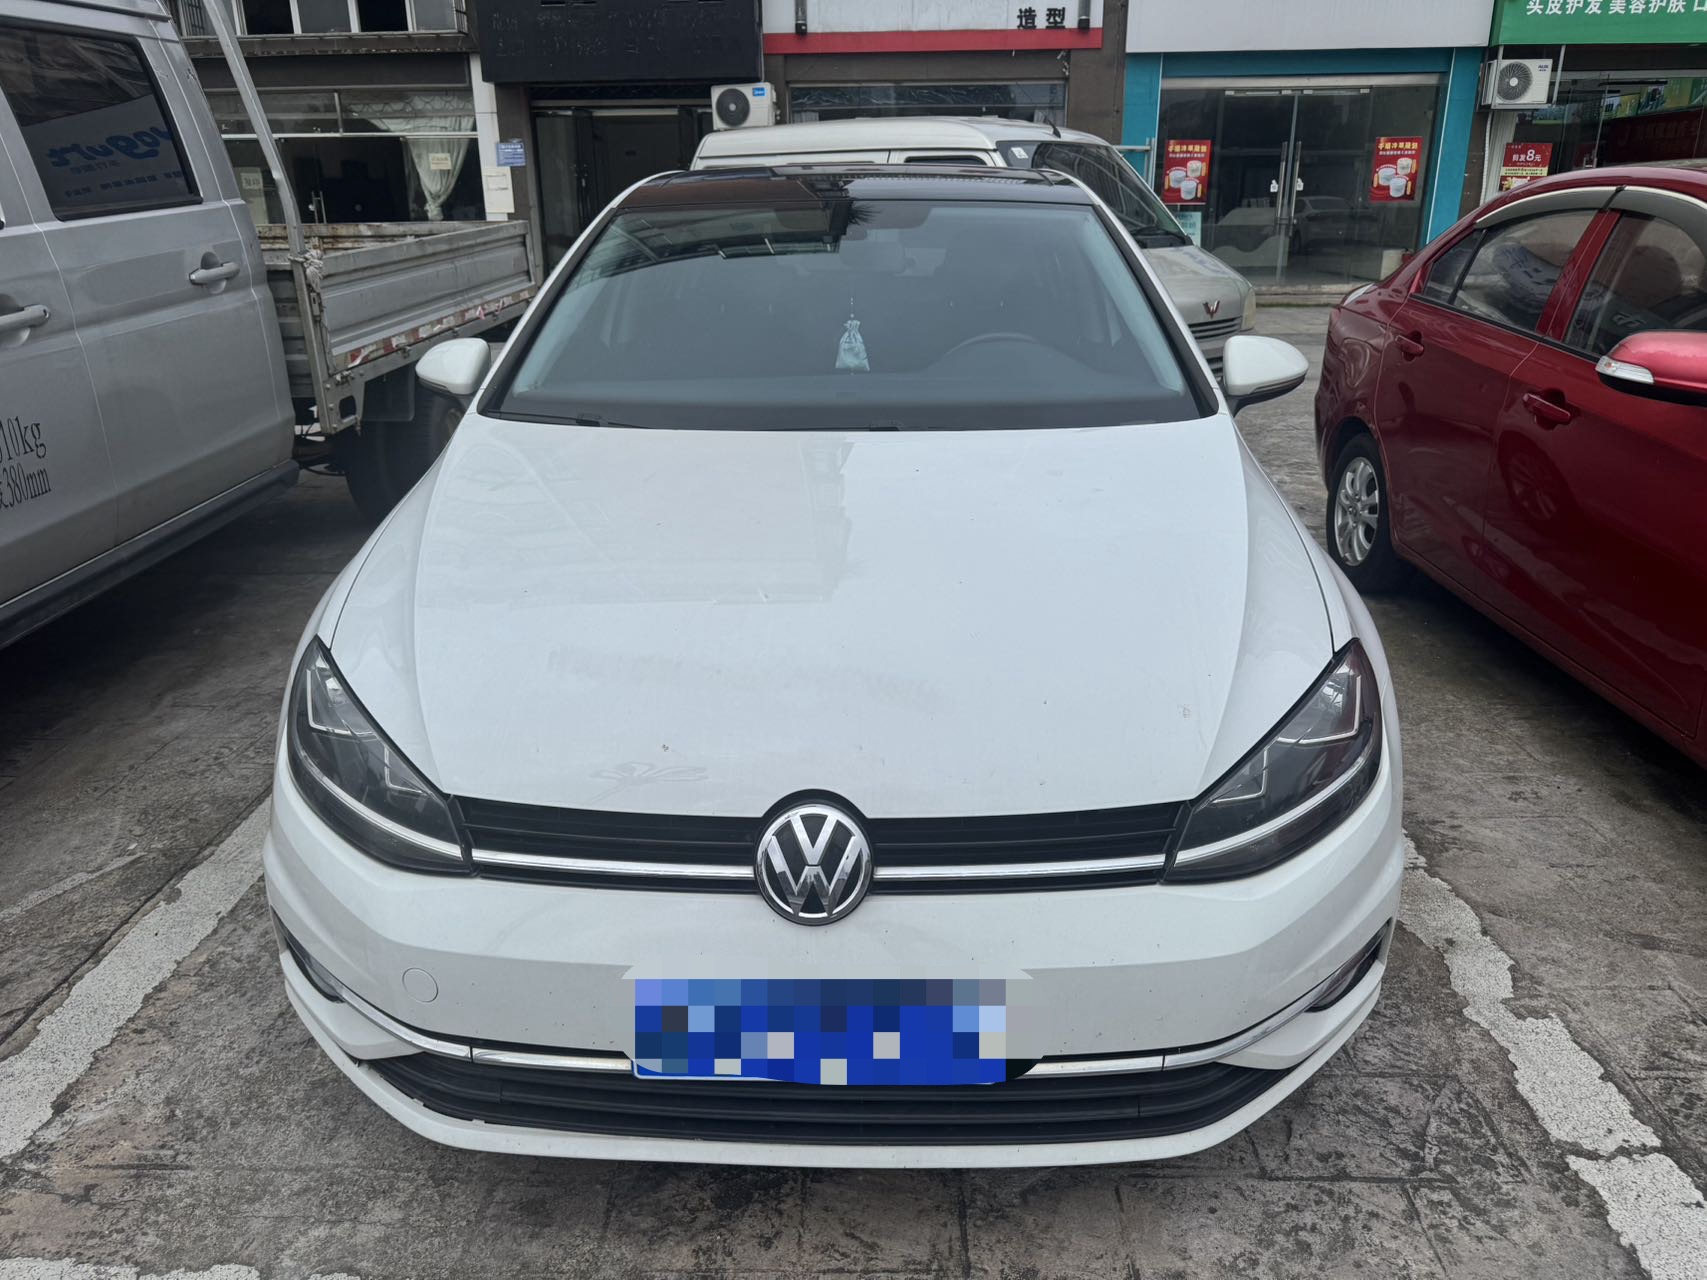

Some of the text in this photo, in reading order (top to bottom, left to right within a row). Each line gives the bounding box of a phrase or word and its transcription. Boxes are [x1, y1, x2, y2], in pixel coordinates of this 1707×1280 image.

[1526, 0, 1602, 15] 头皮护发
[1608, 0, 1687, 14] 美容护肤
[1017, 7, 1066, 29] 造型
[1512, 149, 1542, 162] 剪发8元
[0, 416, 46, 463] 10kg
